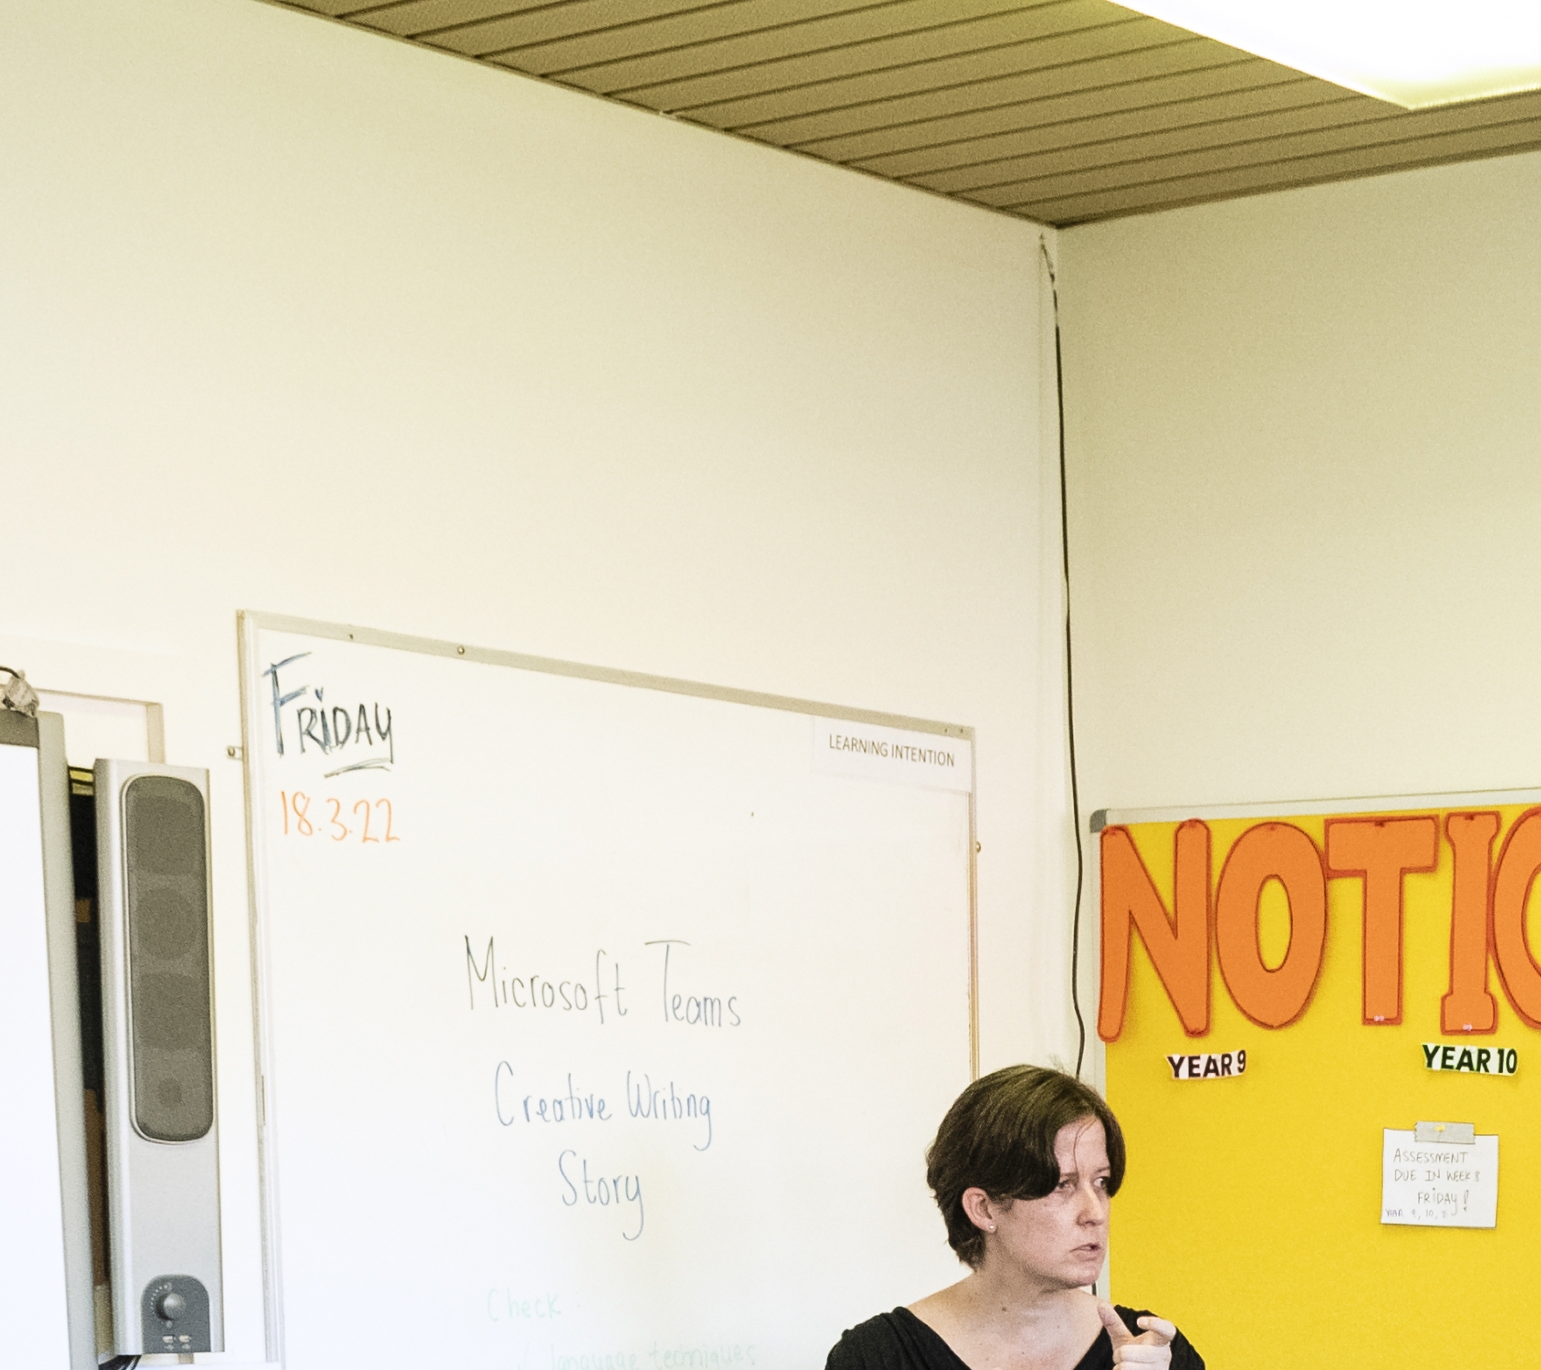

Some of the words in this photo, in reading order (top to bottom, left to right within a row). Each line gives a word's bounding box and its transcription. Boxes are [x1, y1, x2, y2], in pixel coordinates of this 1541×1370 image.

[829, 733, 888, 757] LEARNING
[890, 744, 956, 768] INTENTION
[279, 790, 401, 844] 18.3.22
[464, 934, 628, 1025] Microsoft
[643, 939, 742, 1028] Teams
[1167, 1054, 1233, 1079] YEAR
[1236, 1050, 1247, 1074] 9
[1421, 1044, 1492, 1074] YEAR
[1497, 1048, 1518, 1074] 10
[494, 1060, 613, 1126] Creative
[626, 1070, 713, 1151] Writing
[1393, 1148, 1469, 1164] ASSESSMENT
[1394, 1169, 1416, 1182] DUE
[1424, 1169, 1440, 1182] IN
[1447, 1171, 1470, 1182] WEEK
[558, 1149, 644, 1241] Story
